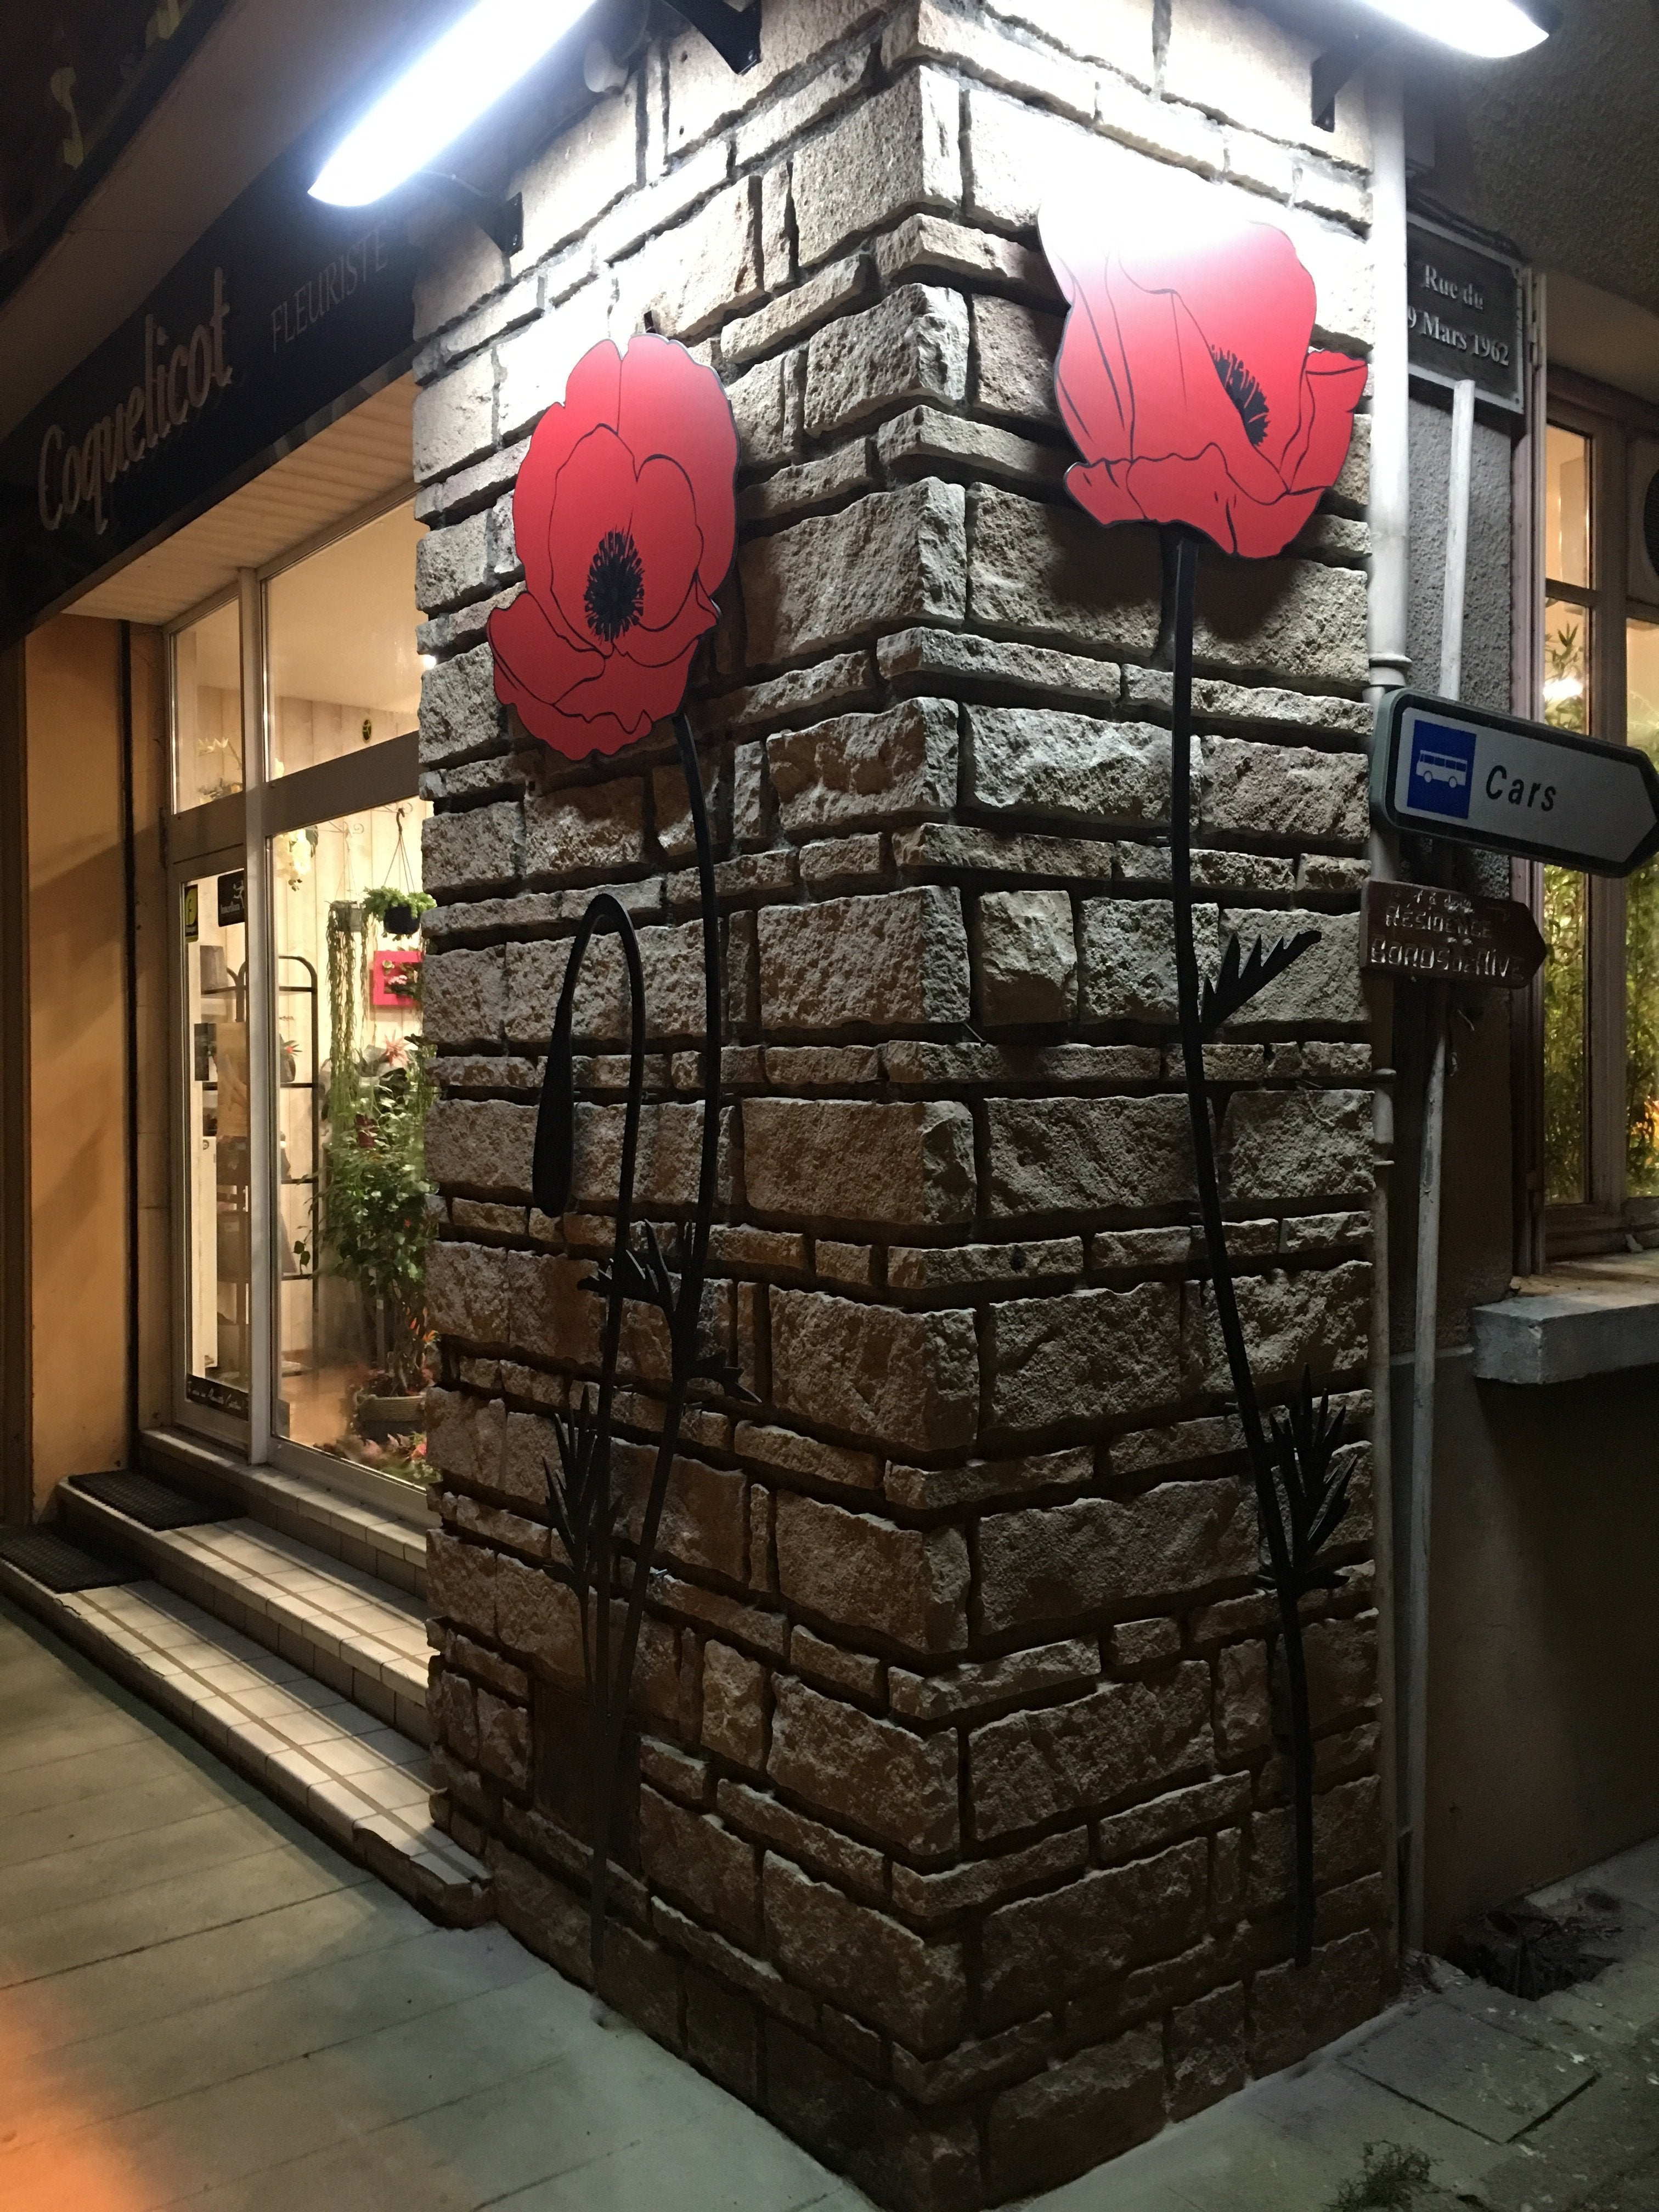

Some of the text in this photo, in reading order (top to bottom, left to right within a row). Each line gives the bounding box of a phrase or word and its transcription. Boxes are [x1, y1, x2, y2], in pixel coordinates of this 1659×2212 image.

[270, 219, 388, 352] FLEURISTE
[1421, 264, 1484, 311] Rue du
[1421, 312, 1468, 350] Mars
[1472, 334, 1509, 366] 1962
[38, 267, 233, 534] Coquelicot
[1486, 765, 1557, 811] Cars
